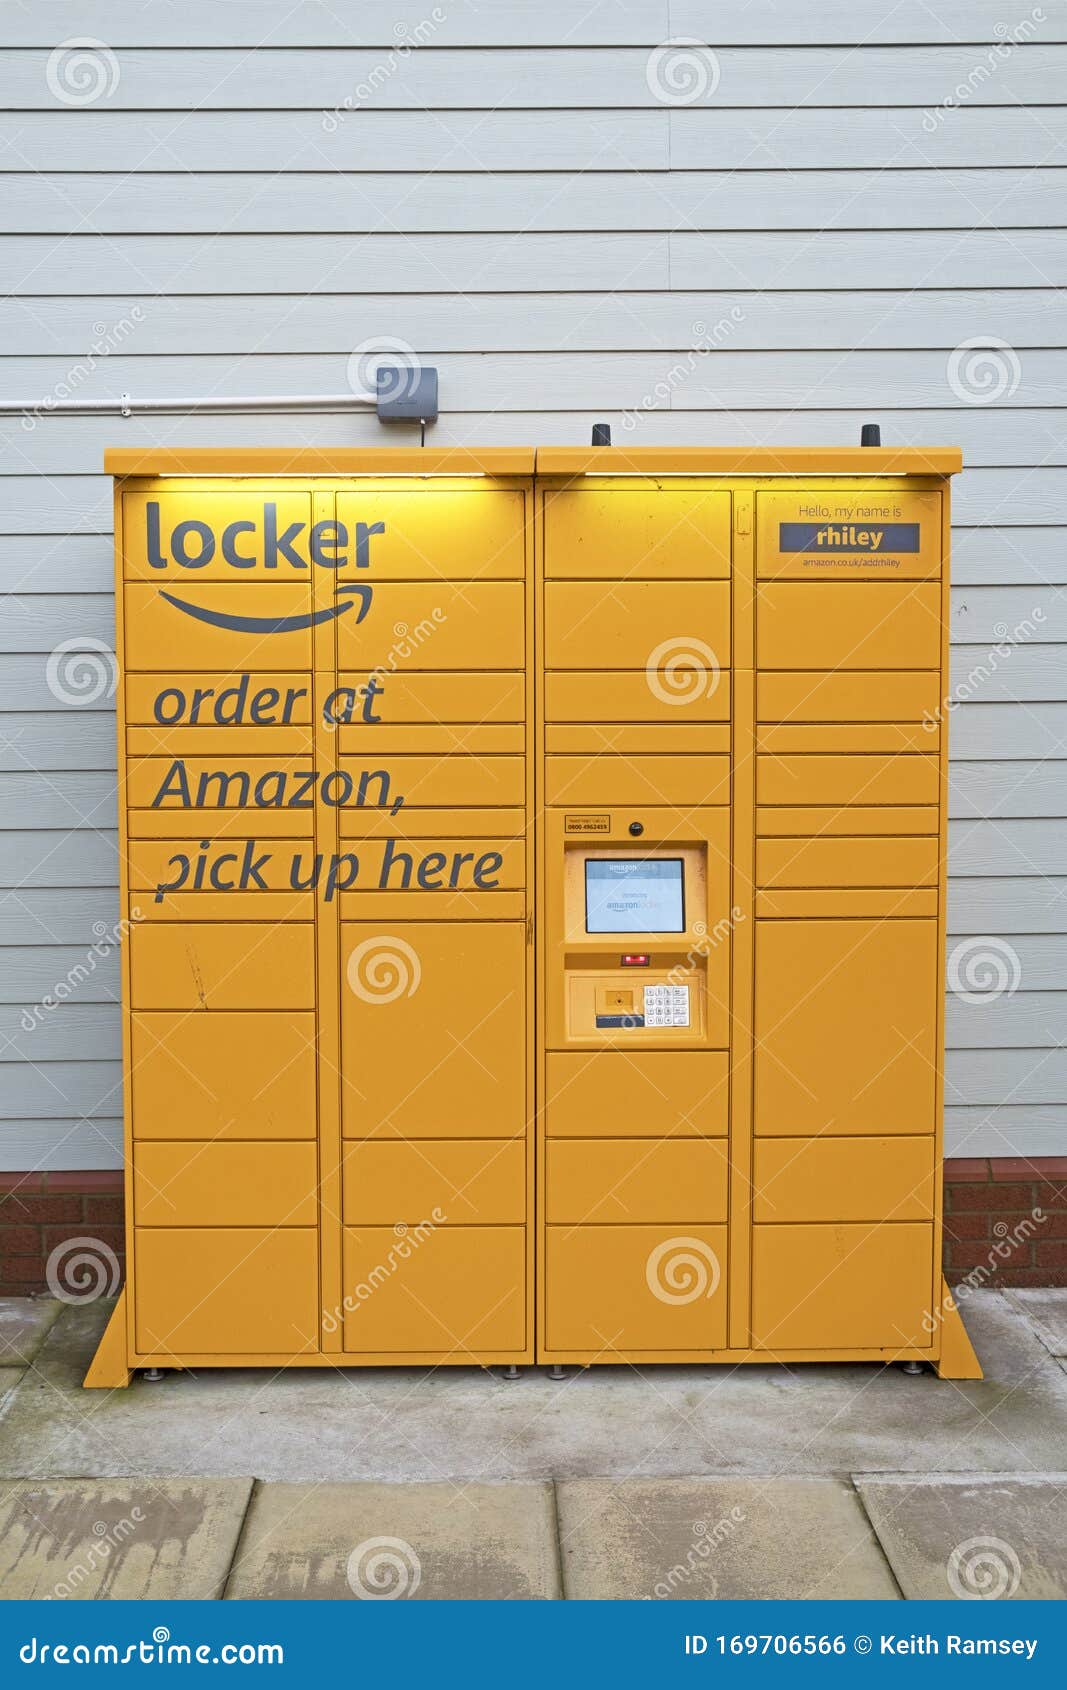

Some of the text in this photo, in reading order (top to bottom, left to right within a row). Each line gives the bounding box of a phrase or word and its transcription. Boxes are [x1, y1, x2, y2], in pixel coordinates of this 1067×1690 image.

[146, 502, 385, 569] locker
[799, 505, 902, 519] Hello, my name is
[803, 558, 900, 568] amazon.co.uk/addrhiley
[817, 526, 883, 550] rhiley
[153, 675, 385, 725] order at
[151, 760, 405, 816] Amazon,
[154, 839, 503, 903] pick up here
